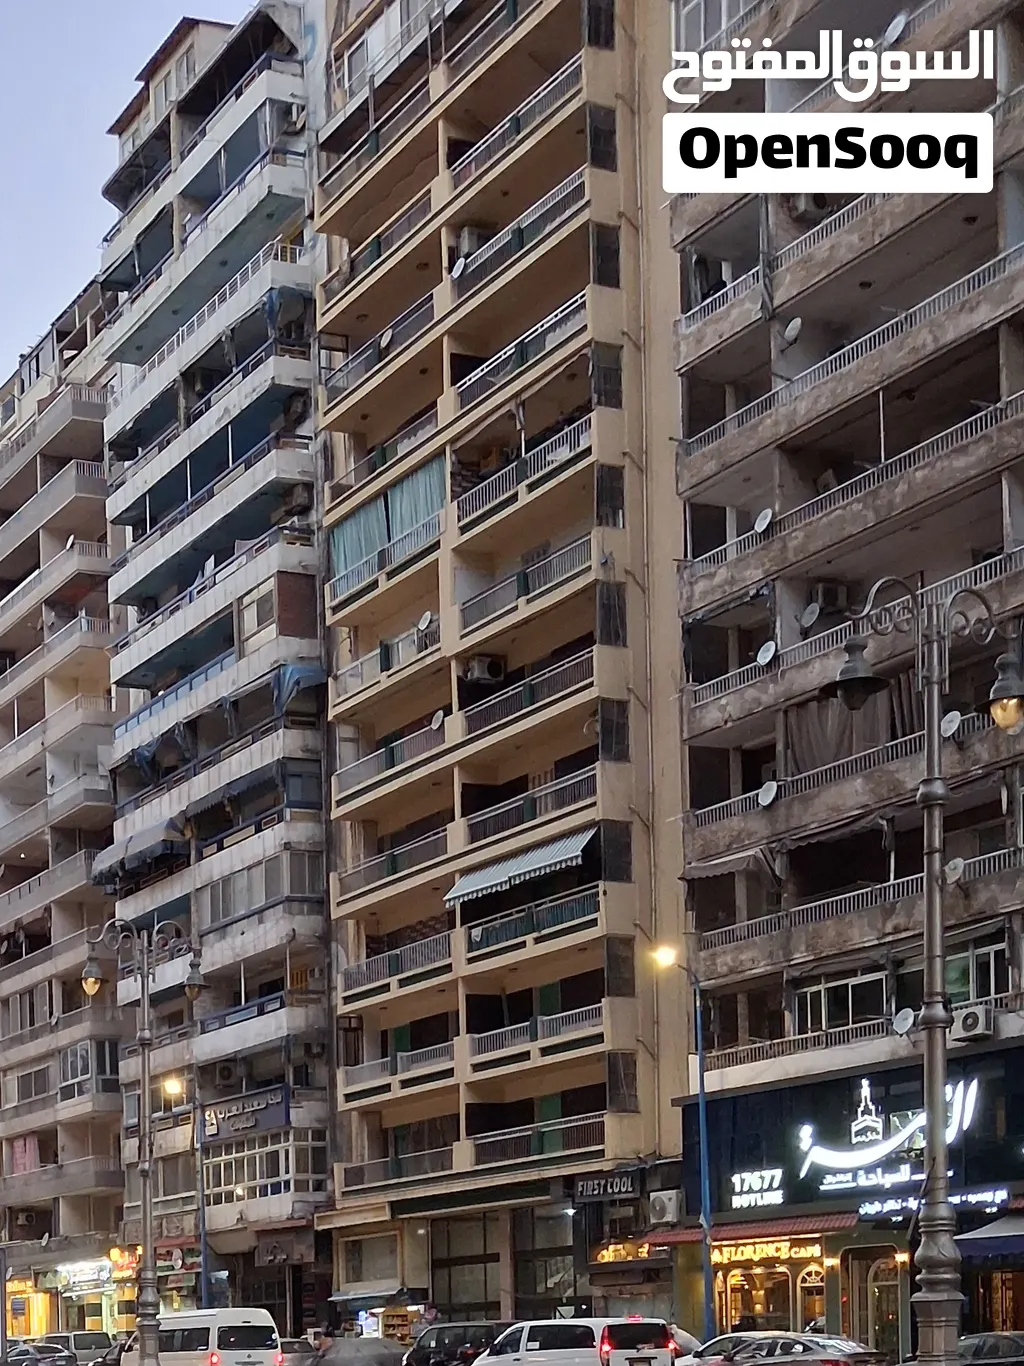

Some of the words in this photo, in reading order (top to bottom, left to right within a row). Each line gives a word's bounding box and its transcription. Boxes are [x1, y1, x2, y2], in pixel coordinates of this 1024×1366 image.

[578, 1179, 606, 1197] FIRST
[607, 1176, 633, 1194] COOL
[731, 1169, 783, 1193] 17677
[857, 1163, 911, 1189] للسياحة
[731, 1190, 784, 1209] HOTLINE
[722, 1241, 791, 1263] FLORENCE
